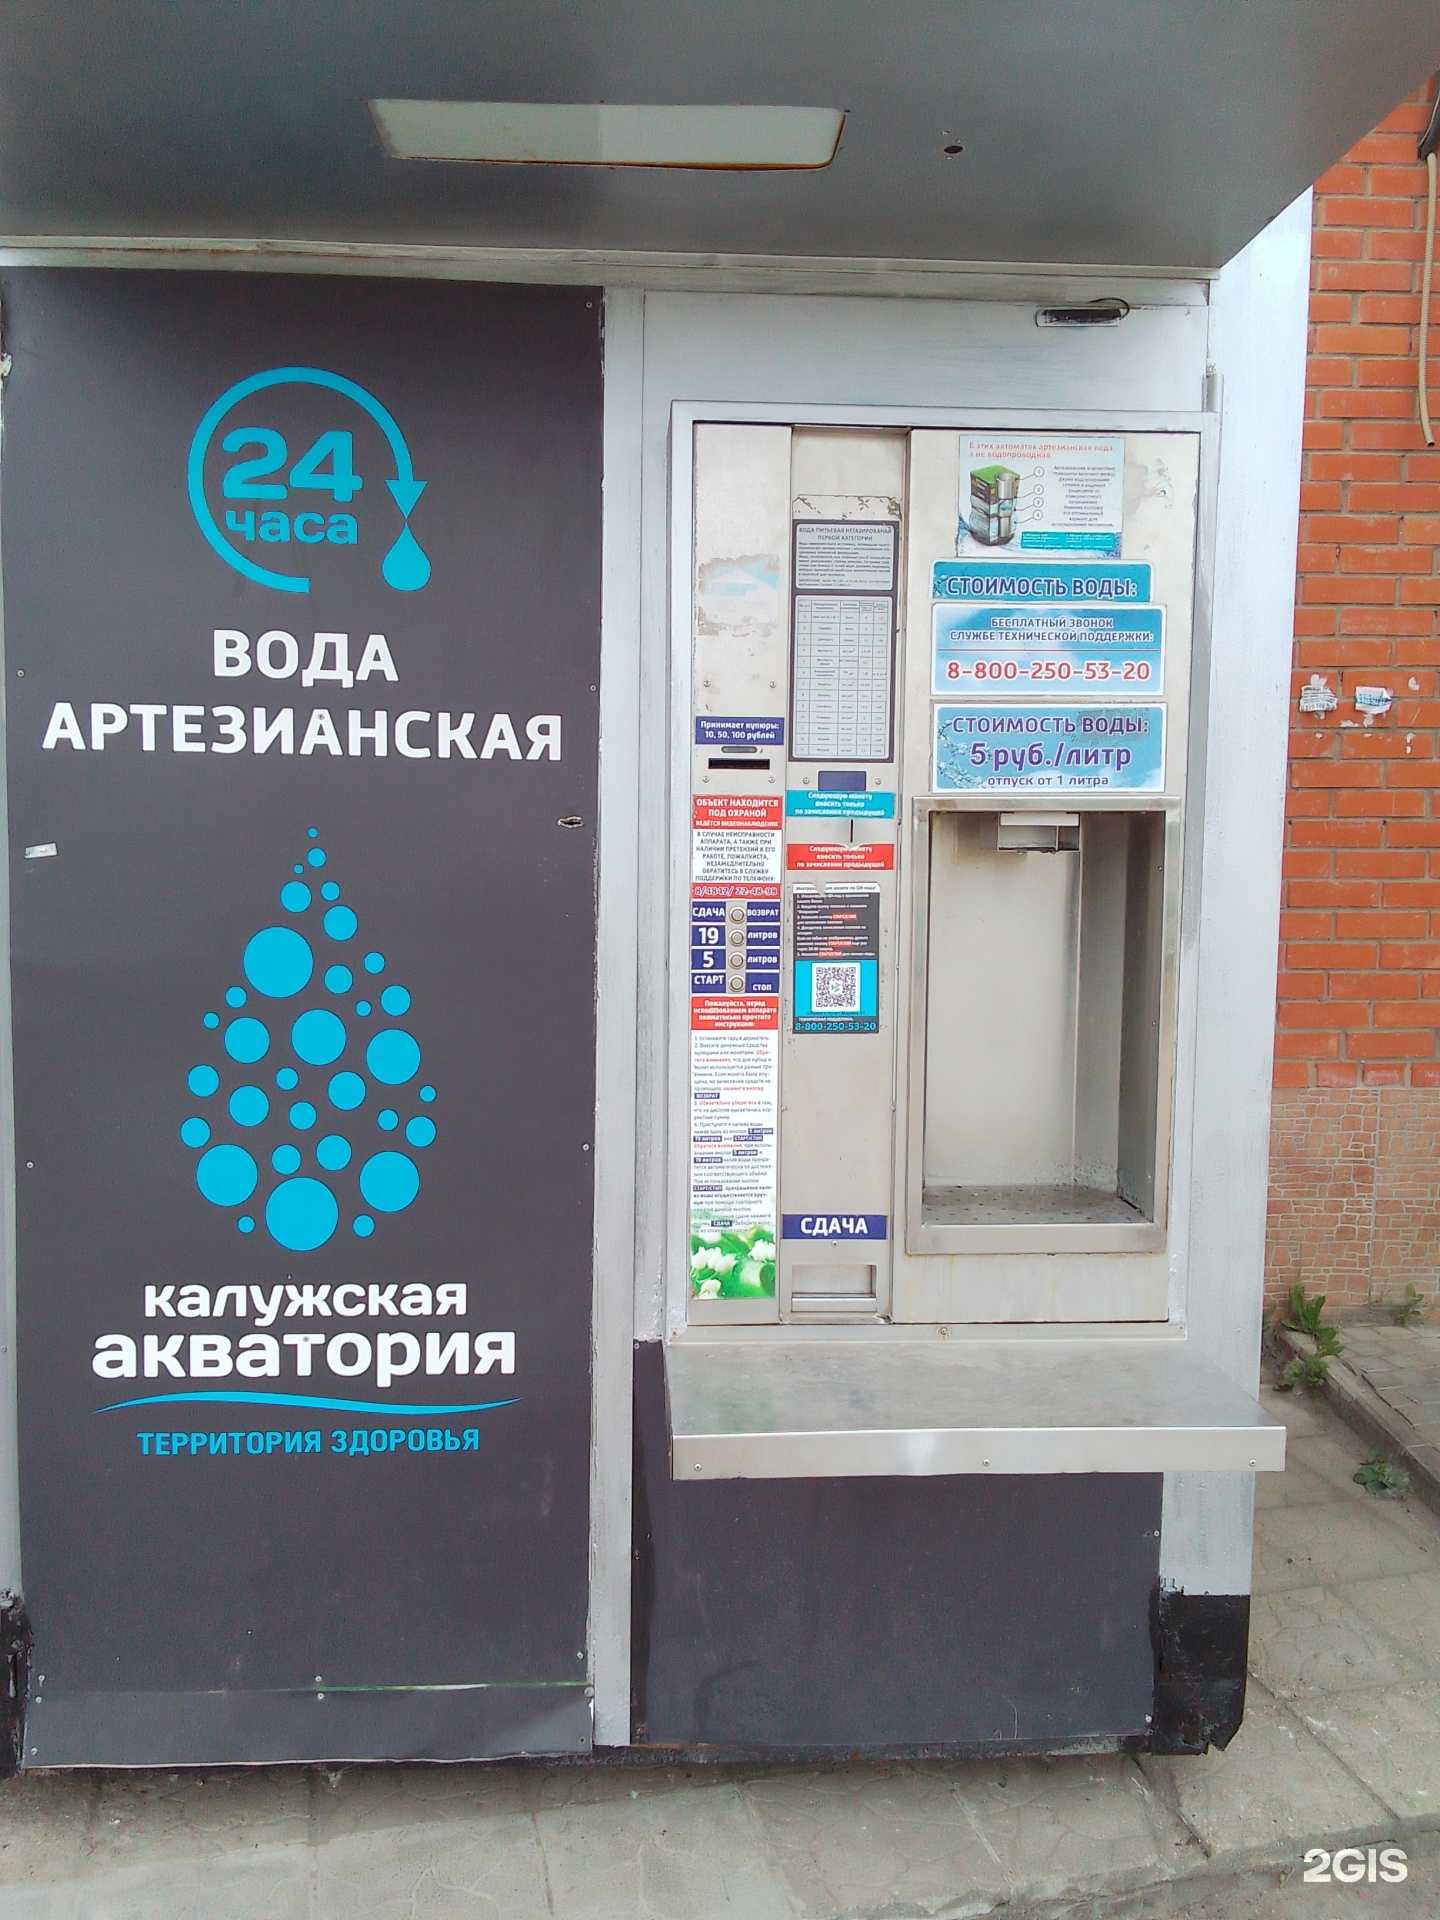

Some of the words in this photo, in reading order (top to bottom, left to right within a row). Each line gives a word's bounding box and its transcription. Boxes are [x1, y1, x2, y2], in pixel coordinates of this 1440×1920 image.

[223, 427, 364, 502] 24
[225, 510, 358, 544] часа
[948, 577, 1067, 597] СТОИМОСТЬ
[1072, 579, 1137, 599] ВОДЫ:
[991, 617, 1067, 629] БЕСПЛАТНЫЙ
[1068, 618, 1113, 629] ЗВОНОК
[950, 631, 996, 641] СЛУЖБЕ
[998, 630, 1077, 642] ТЕХНИЧЕСКОЙ
[1079, 632, 1153, 643] ПОДДЕРЖКИ:
[213, 629, 401, 689] ВОДА
[947, 661, 1150, 680] 8-800-250-53-20
[41, 701, 562, 761] АРТЕЗИАНСКАЯ
[701, 720, 744, 730] Принимает
[953, 717, 1076, 734] СТОИМОСТЬ
[1081, 717, 1149, 735] ВОДЫ:
[732, 731, 745, 739] 100
[747, 731, 776, 742] рублей
[970, 743, 986, 766] 5
[993, 742, 1132, 772] руб./литр
[987, 776, 1033, 788] отпуск
[1037, 777, 1054, 786] от
[1056, 775, 1063, 785] 1
[1068, 776, 1109, 788] литра
[696, 798, 728, 807] ОБЪЕКТ
[730, 799, 779, 808] НАХОДИТСЯ
[708, 808, 727, 818] ПОД
[728, 807, 767, 817] ОХРАНОЙ
[726, 831, 775, 839] НЕИСПРАВНОСТИ
[693, 907, 725, 917] СДАЧА
[747, 908, 779, 917] ВОЗВРАТ
[698, 927, 719, 945] 19
[747, 932, 778, 942] литров
[703, 950, 714, 970] 5
[747, 956, 778, 967] литров
[694, 975, 725, 985] СТАРТ
[801, 1217, 869, 1237] СДАЧА
[144, 1282, 468, 1328] калужская
[91, 1330, 517, 1389] акватория
[139, 1430, 322, 1456] ТЕРРИТОРИЯ
[330, 1428, 480, 1456] ЗДОРОВЬЯ
